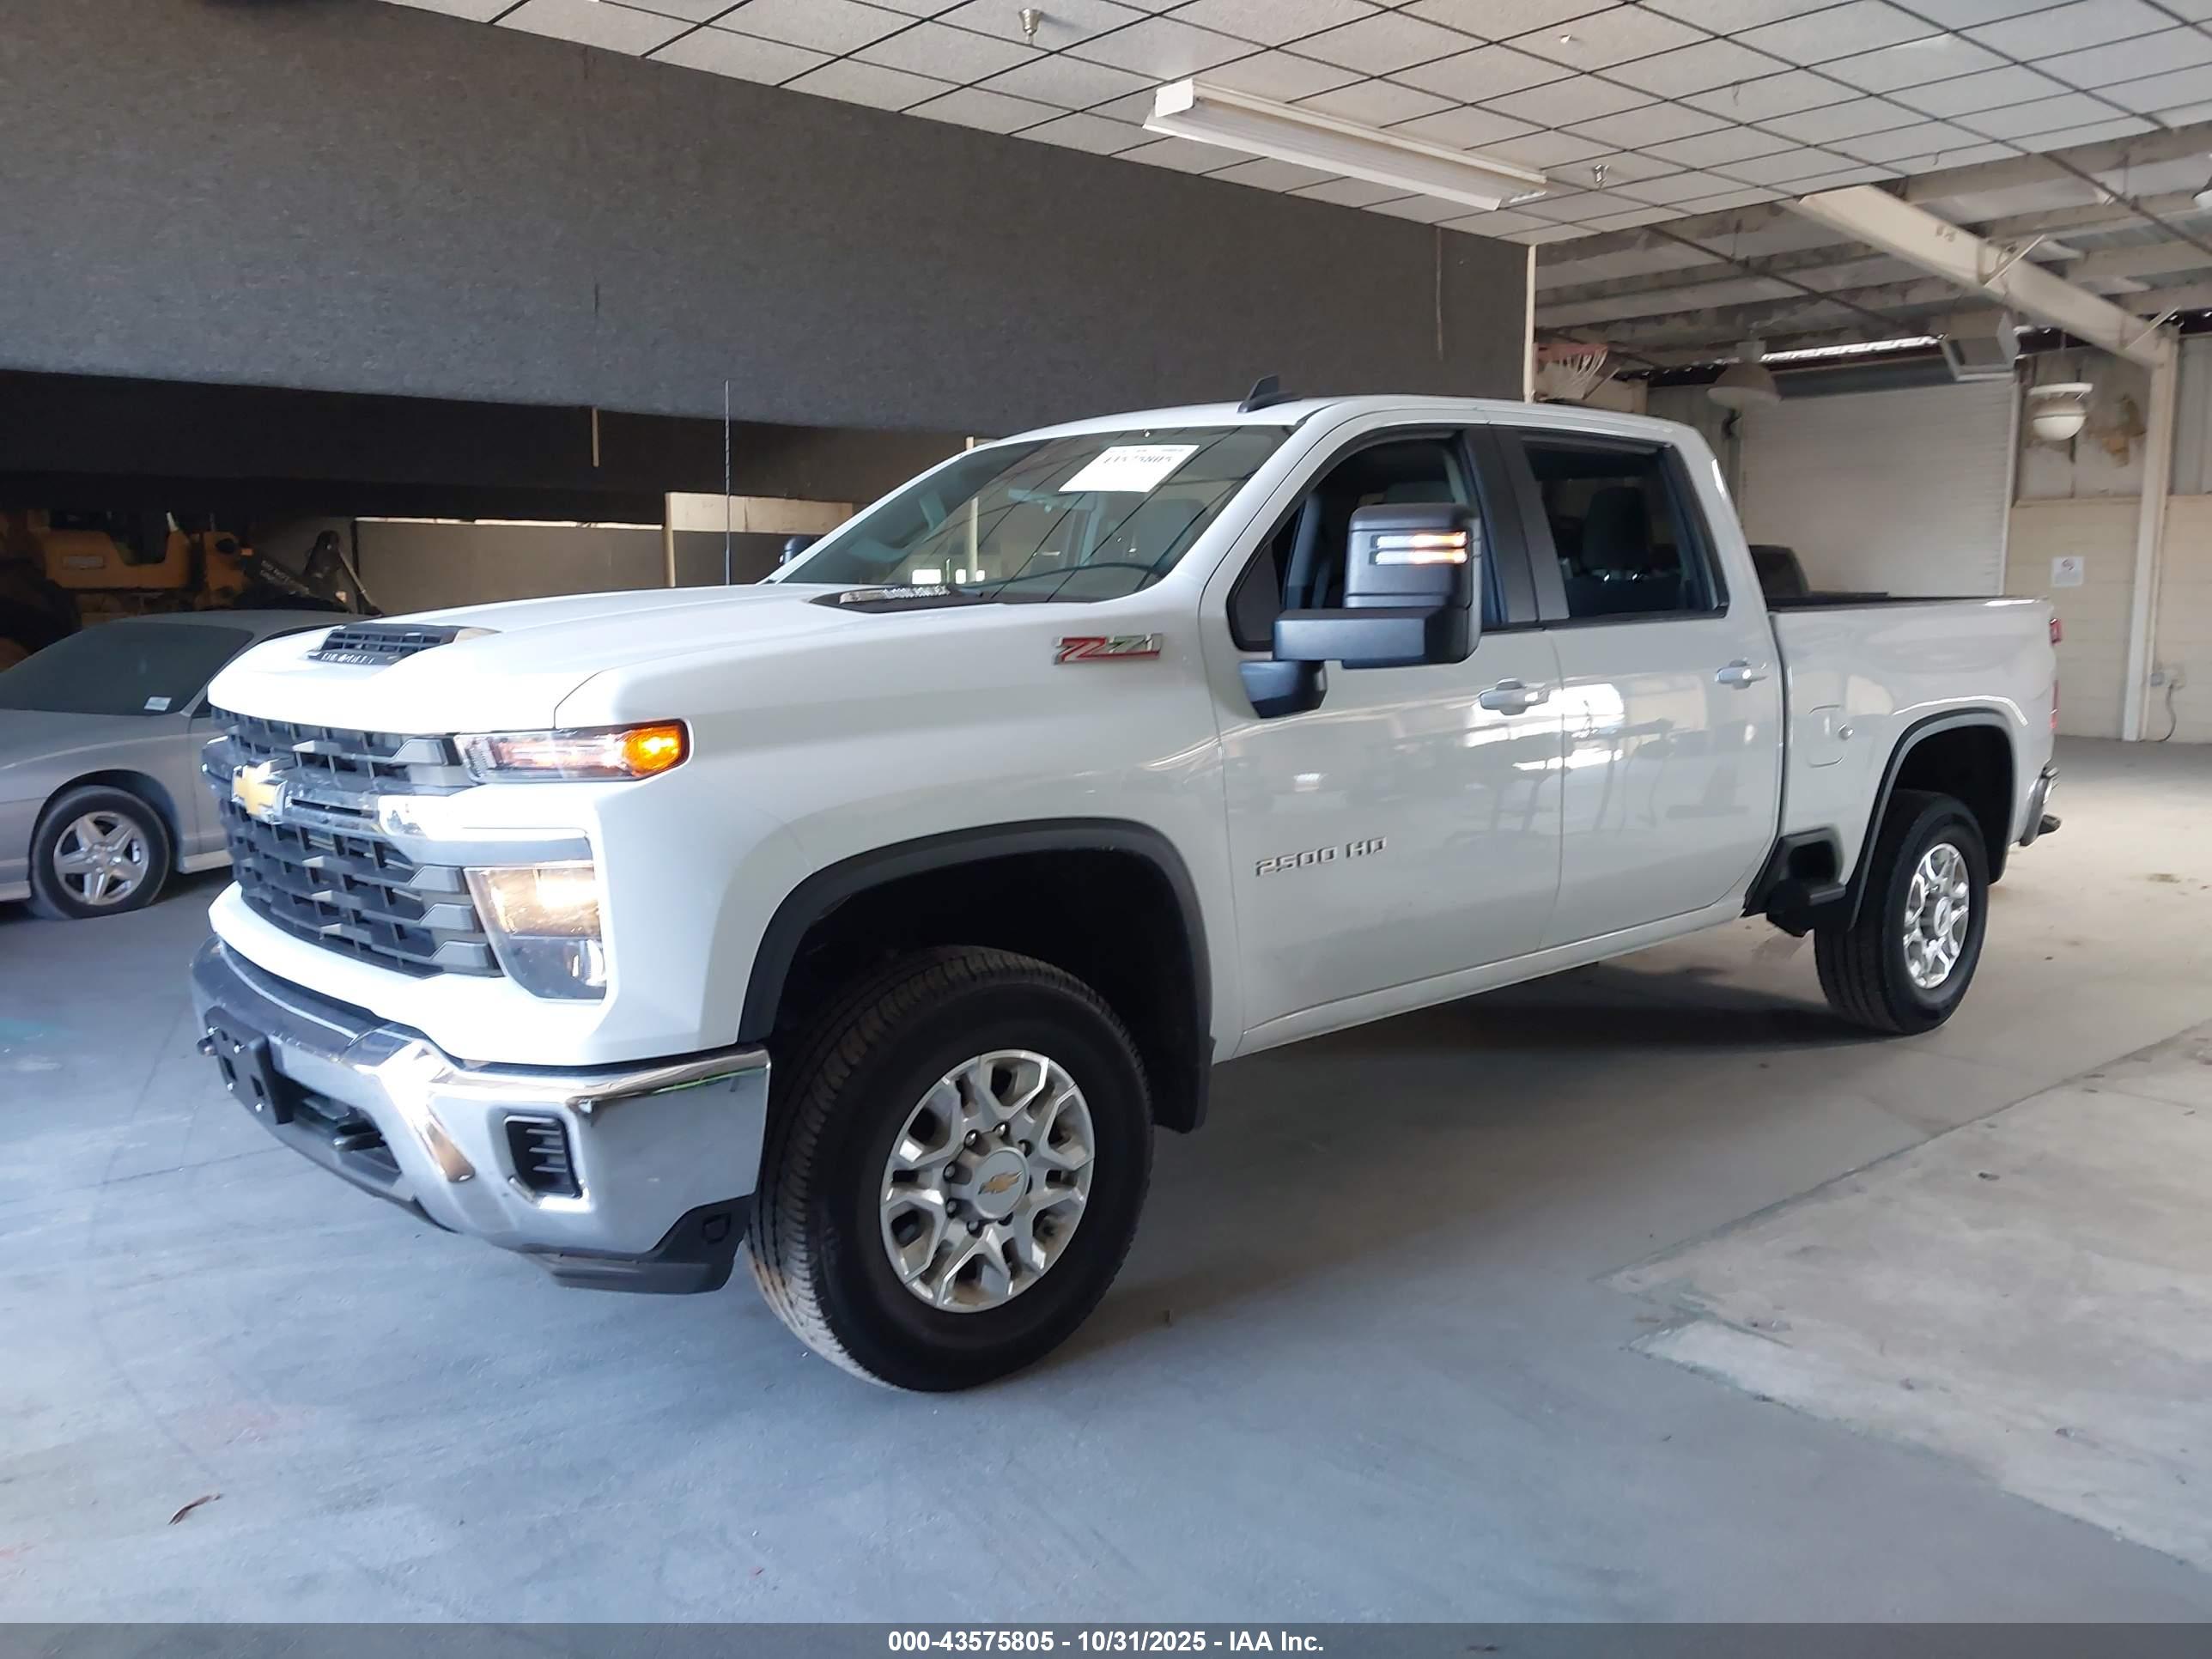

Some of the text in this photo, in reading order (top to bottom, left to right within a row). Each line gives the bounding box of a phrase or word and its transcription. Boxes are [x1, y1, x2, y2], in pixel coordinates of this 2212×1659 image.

[1053, 633, 1163, 665] Z71
[1255, 836, 1387, 877] 2500 HD
